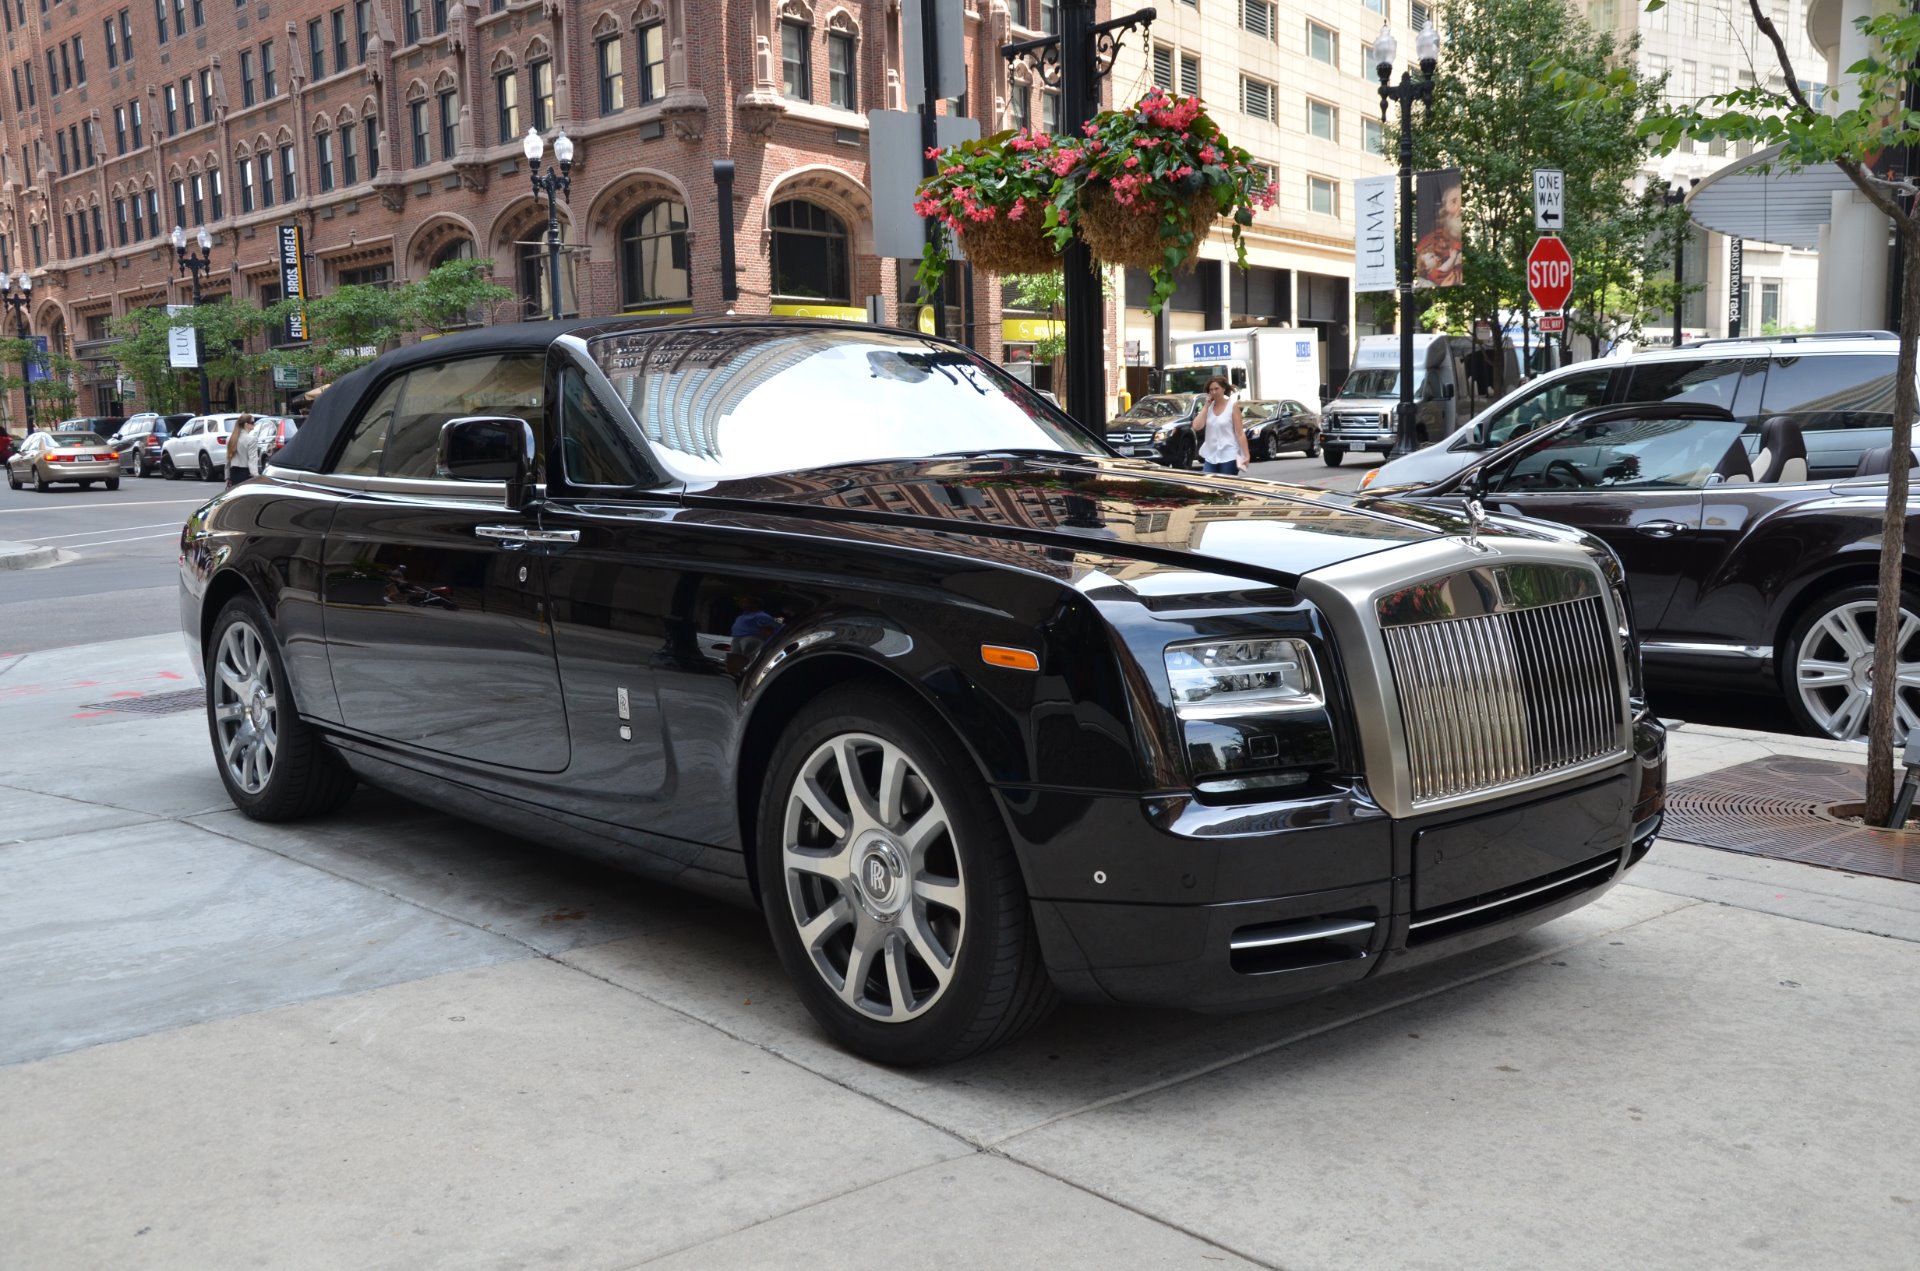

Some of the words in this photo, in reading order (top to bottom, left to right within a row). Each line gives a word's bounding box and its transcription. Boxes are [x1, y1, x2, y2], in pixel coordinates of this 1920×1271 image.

[1538, 175, 1560, 190] ONE
[1538, 192, 1560, 206] WAY
[1366, 190, 1385, 268] LUMA
[283, 228, 297, 264] BAGELS
[1531, 260, 1570, 288] STOP
[1731, 238, 1740, 295] NORDSTROM
[1729, 297, 1741, 322] rack
[1541, 320, 1551, 329] ALL
[1551, 320, 1562, 329] WAY
